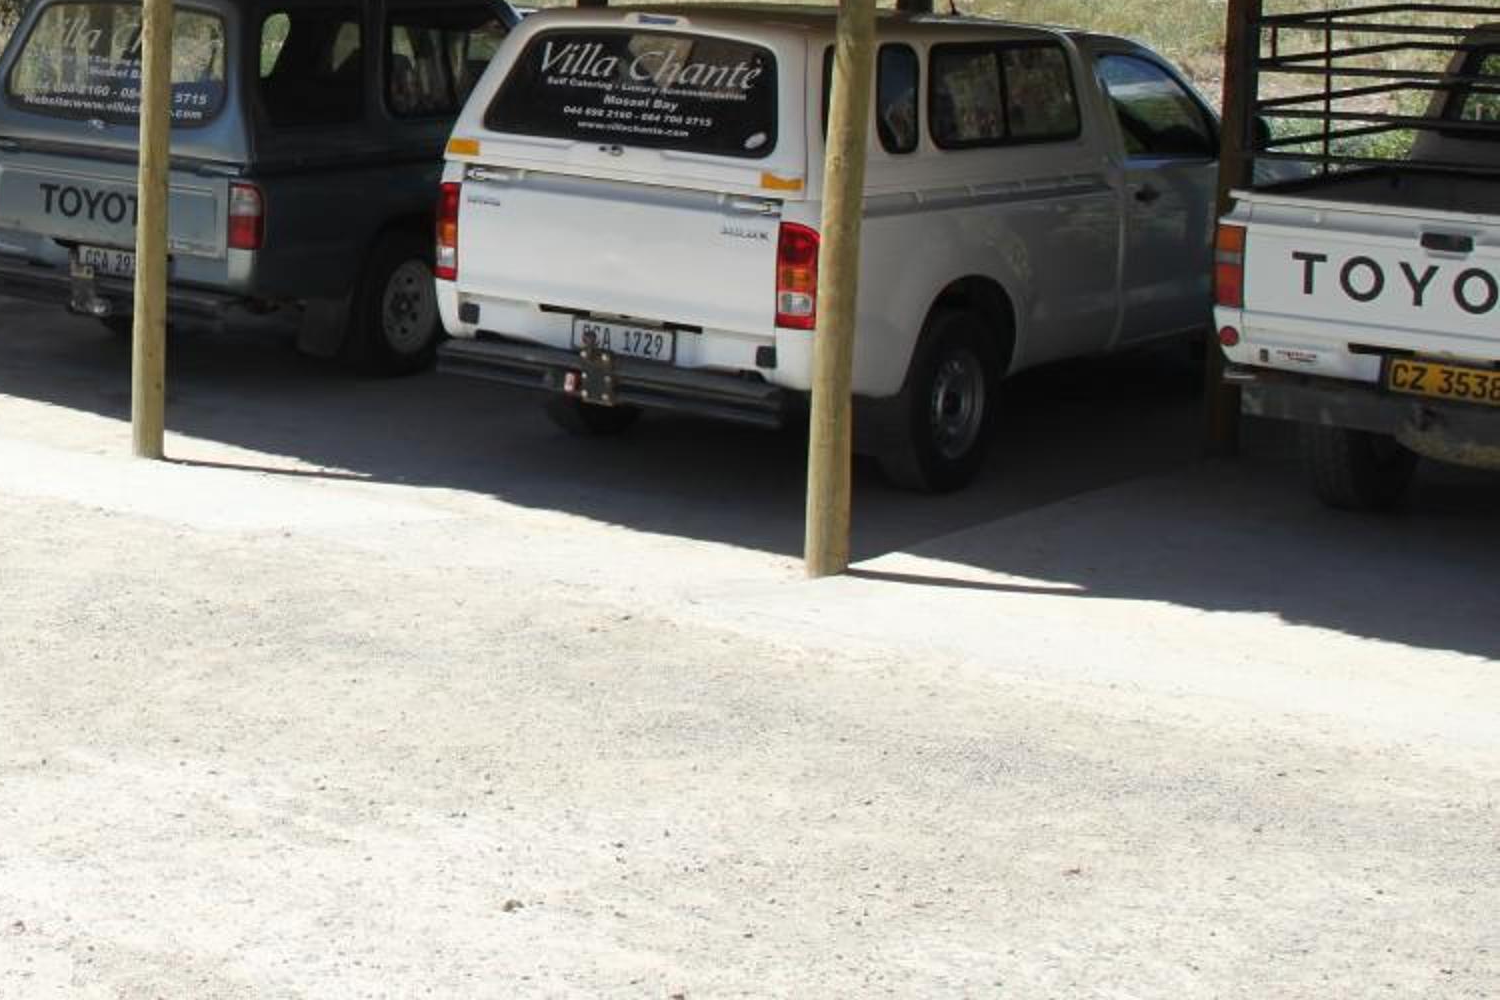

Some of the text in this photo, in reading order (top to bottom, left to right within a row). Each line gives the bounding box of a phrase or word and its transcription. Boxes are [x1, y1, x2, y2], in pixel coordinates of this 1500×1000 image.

[541, 41, 618, 77] Villa
[174, 92, 208, 105] 5715
[652, 99, 679, 113] Bay
[39, 183, 140, 227] TOYOT
[1291, 250, 1500, 314] TOYO
[622, 330, 664, 358] 1729
[1391, 363, 1429, 390] CZ
